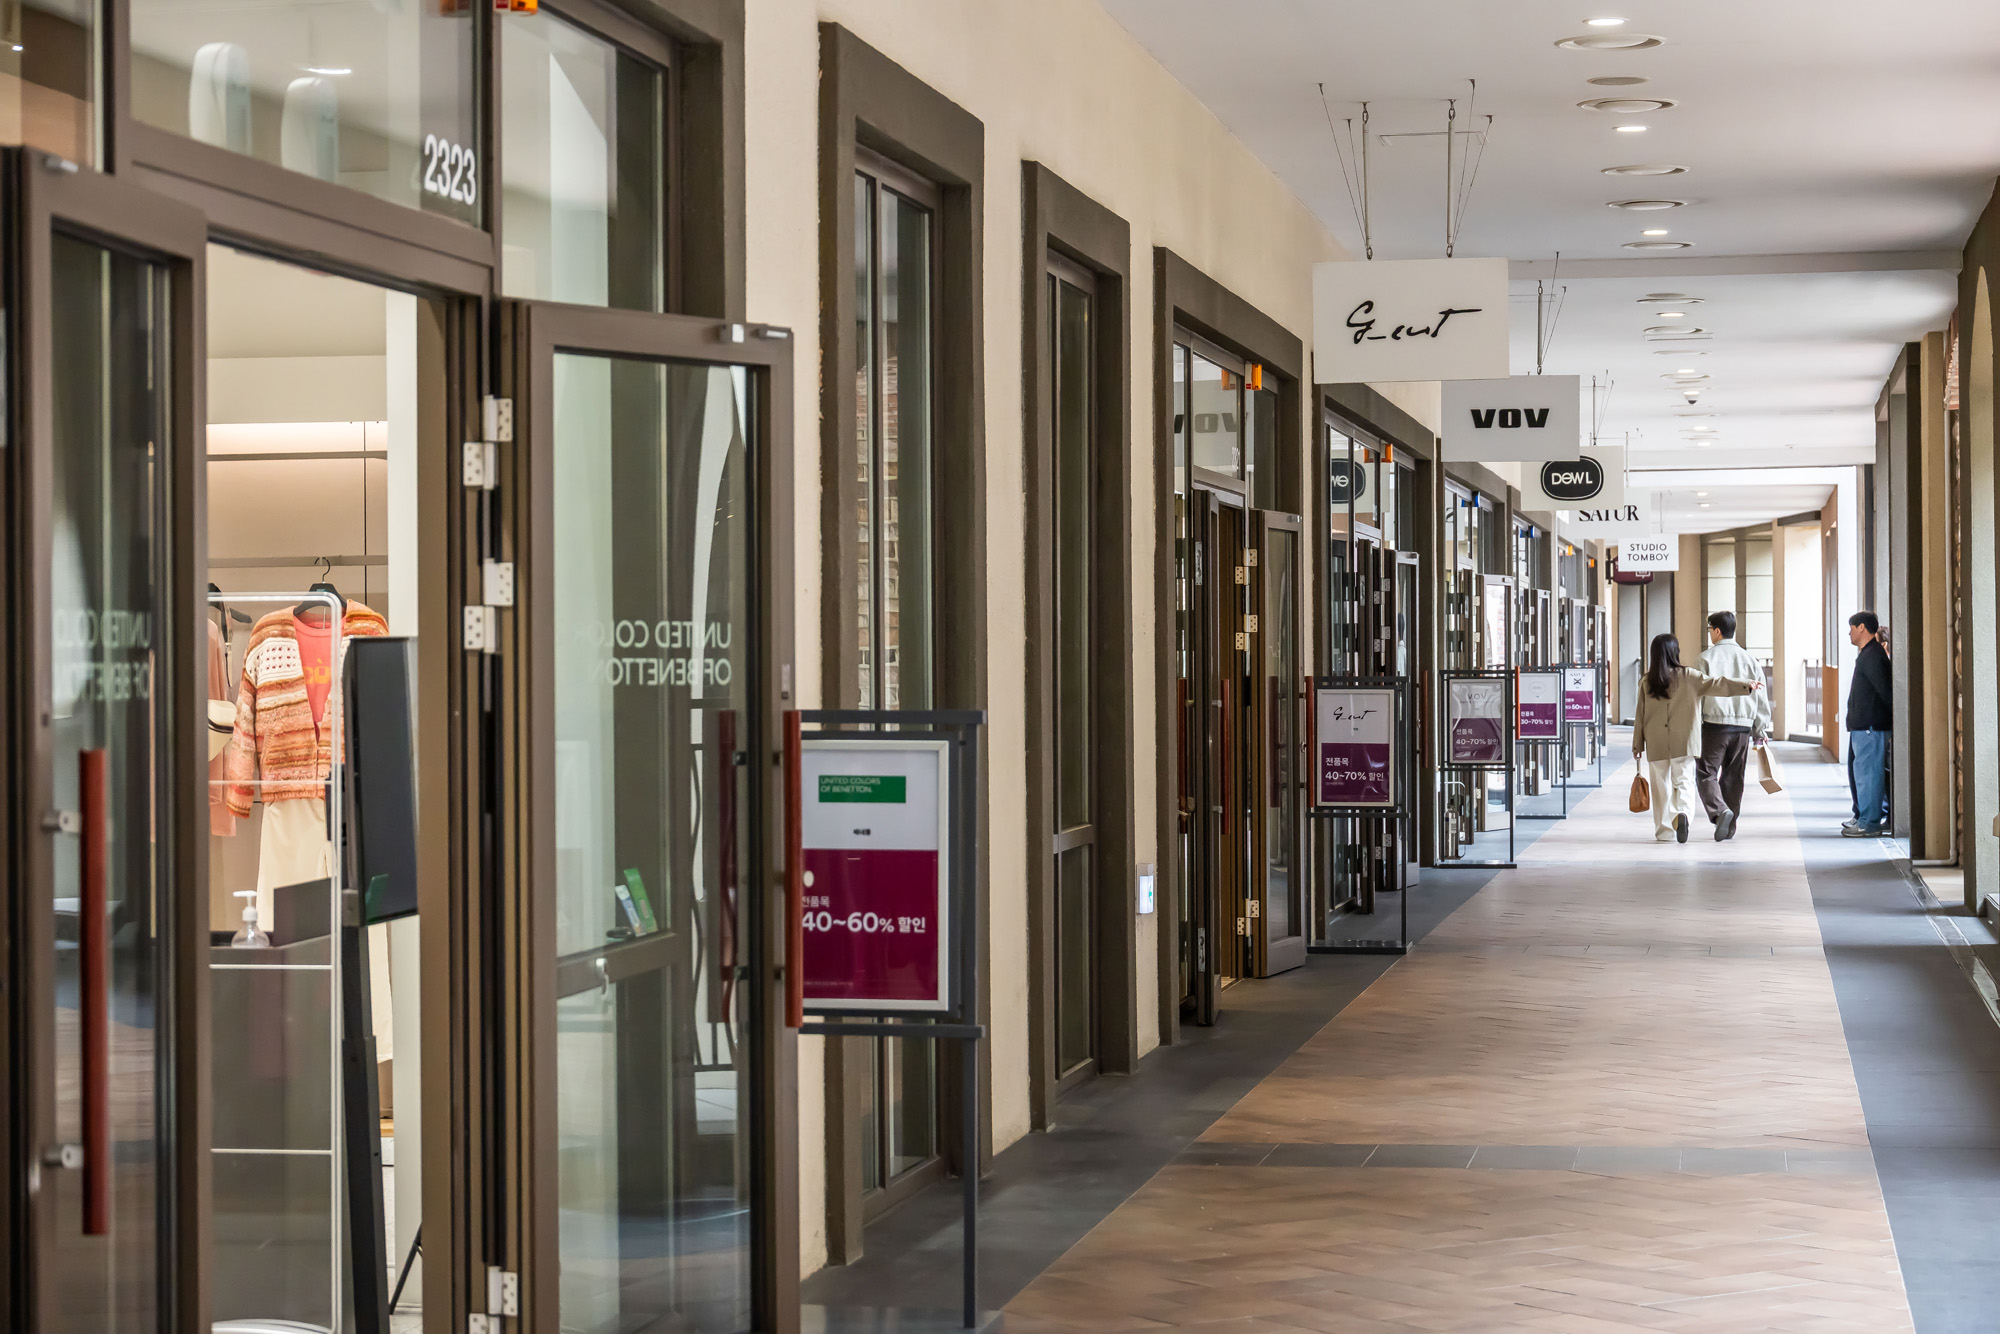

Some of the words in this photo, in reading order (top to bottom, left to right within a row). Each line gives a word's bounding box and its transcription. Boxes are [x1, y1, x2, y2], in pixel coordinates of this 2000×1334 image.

[424, 133, 477, 206] 2323
[1470, 408, 1550, 428] VOV
[1630, 543, 1667, 552] STUDIO
[1627, 553, 1669, 562] TOMBOY
[1325, 757, 1350, 767] 전품목
[1368, 772, 1385, 782] 할인
[897, 916, 926, 934] 할인
